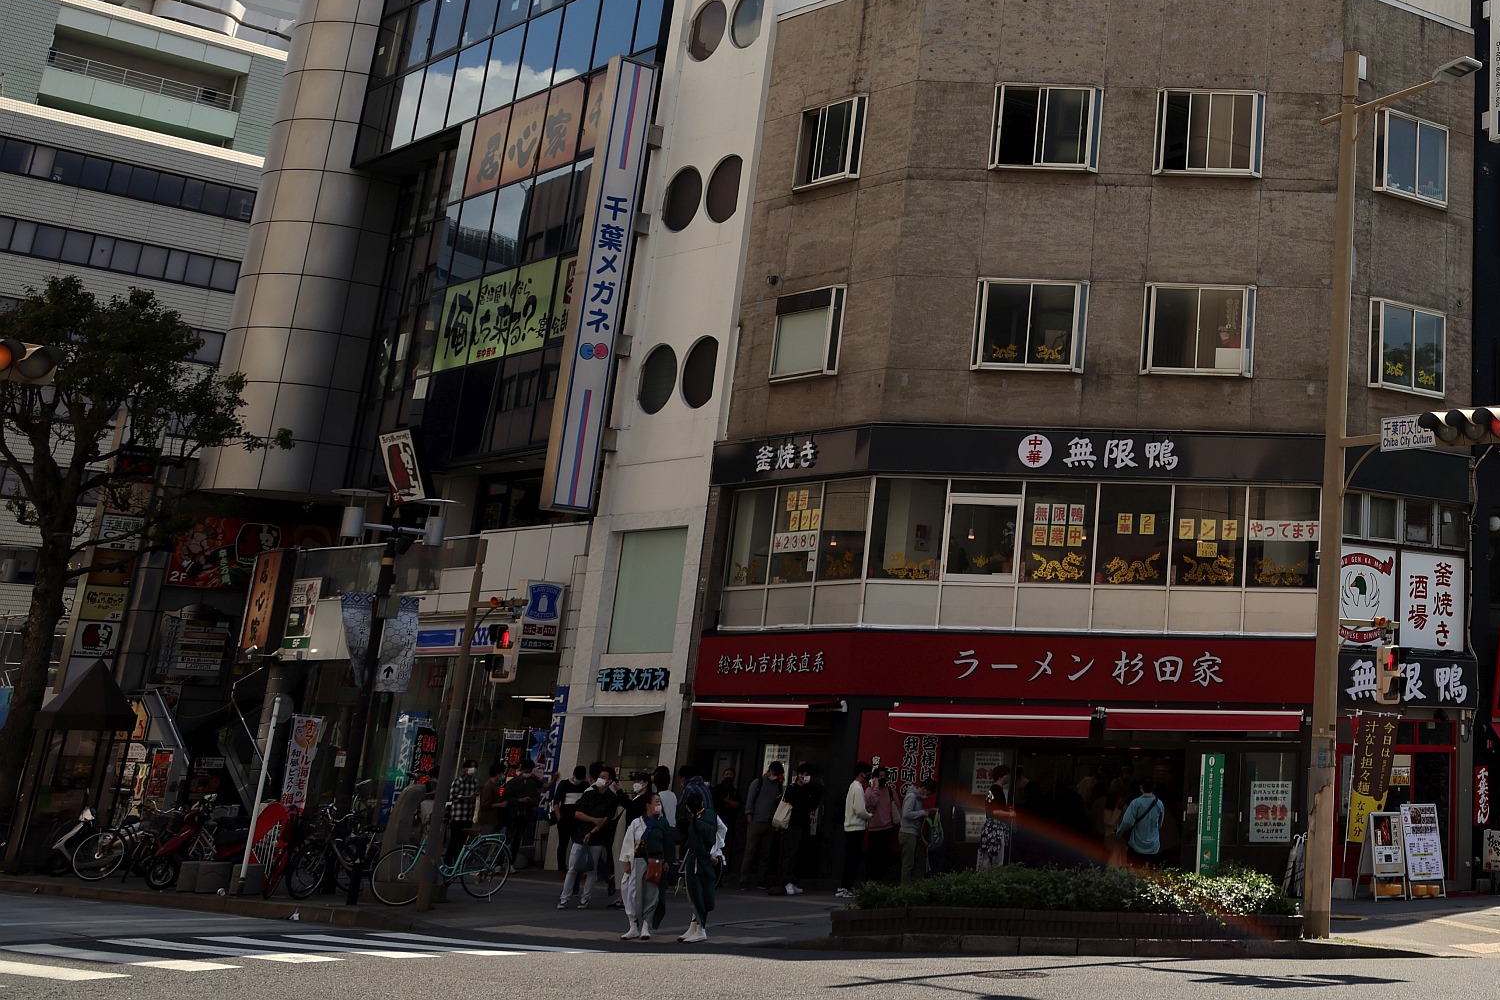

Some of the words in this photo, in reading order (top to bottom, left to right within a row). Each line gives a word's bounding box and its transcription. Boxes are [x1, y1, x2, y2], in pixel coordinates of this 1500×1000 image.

[586, 196, 628, 332] 千葉メガネ
[1384, 419, 1430, 437] 千葉市文化
[1026, 436, 1043, 465] 中華
[1383, 437, 1399, 447] Chiba
[1400, 436, 1412, 447] City
[1413, 434, 1433, 445] Culture
[756, 441, 818, 472] 釜焼き
[1062, 436, 1179, 471] 無限鴨
[791, 511, 819, 529] ダック
[1034, 505, 1084, 523] 無限鴨
[1119, 514, 1131, 534] 中華
[1143, 515, 1152, 533] 2F
[1032, 526, 1082, 545] 営業中
[1180, 519, 1236, 539] ランチ
[1250, 521, 1320, 540] やってます
[775, 533, 817, 550] ¥2380
[169, 571, 187, 582] 2F
[1407, 574, 1429, 631] 酒場
[1433, 562, 1454, 647] 釜焼き
[716, 651, 825, 675] 総本山吉村家直系
[953, 649, 1095, 682] ラーメン
[1111, 650, 1225, 688] 杉田家
[597, 667, 671, 691] 千葉メガネ
[1380, 721, 1396, 758] 今日は
[1356, 720, 1379, 796] 汁なし担々麺
[1477, 767, 1490, 825] 千葉おでん
[1254, 804, 1288, 821] 食券
[1353, 801, 1365, 838] な気分
